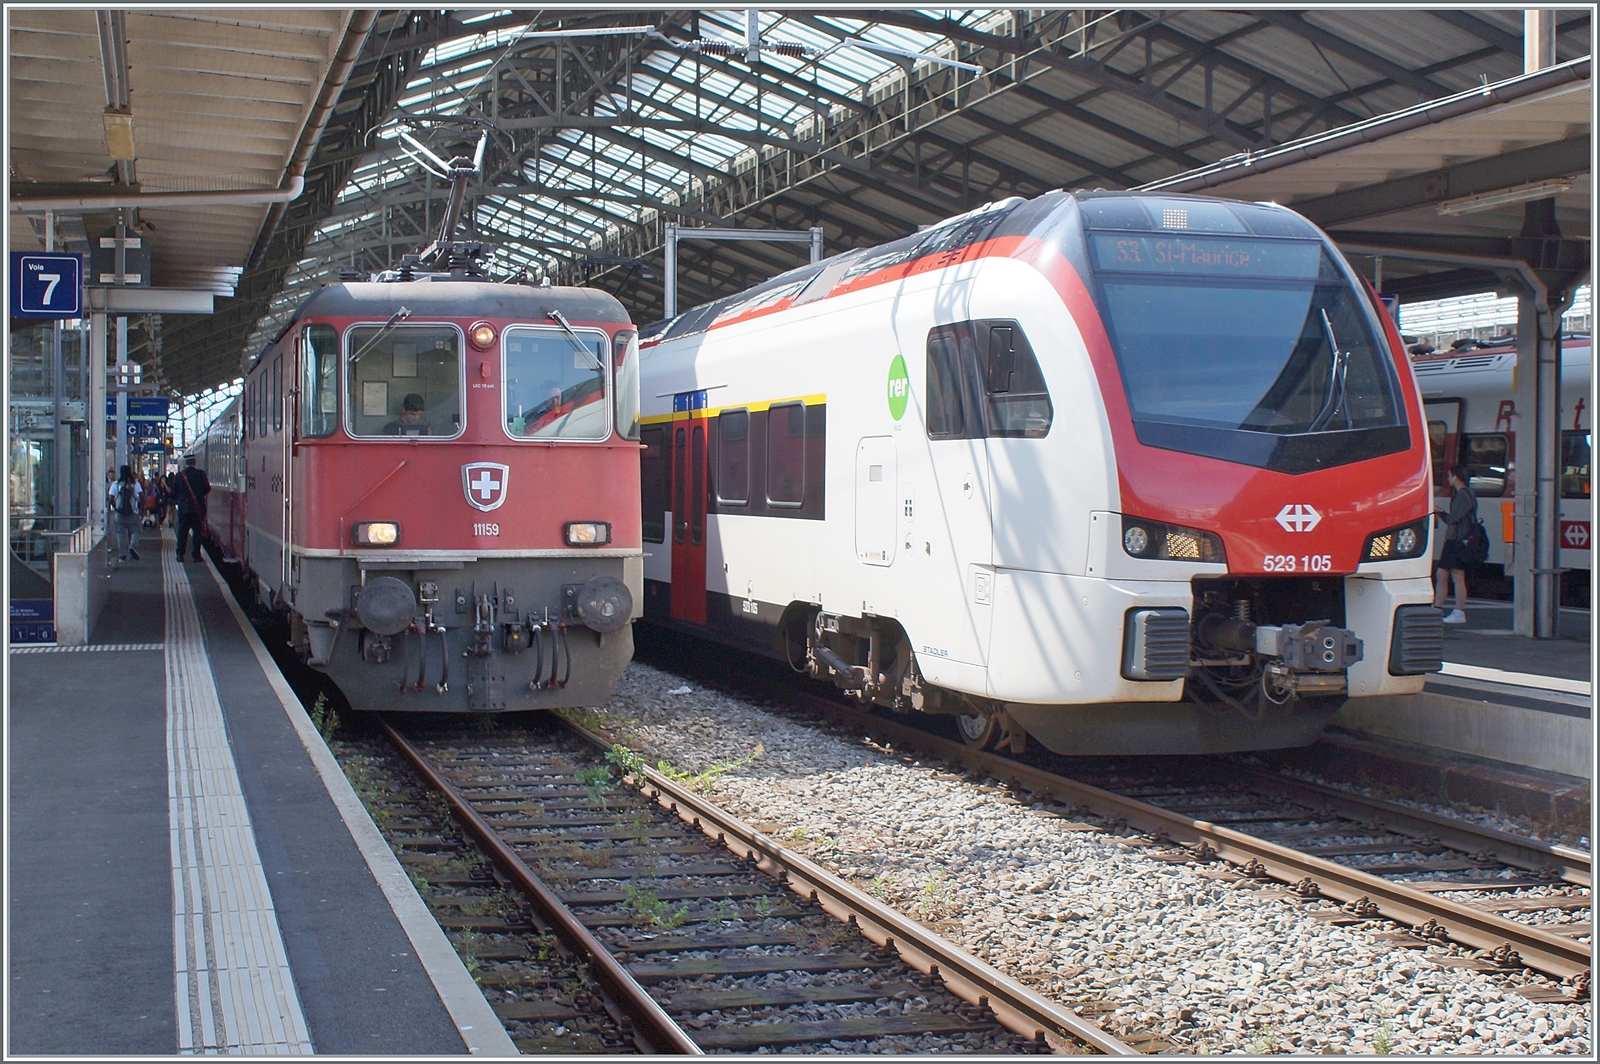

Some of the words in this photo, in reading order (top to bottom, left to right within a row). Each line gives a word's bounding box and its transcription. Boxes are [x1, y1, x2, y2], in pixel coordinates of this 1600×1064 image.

[1117, 239, 1141, 262] S3
[28, 263, 45, 271] Voie
[38, 273, 61, 306] 7
[889, 377, 908, 399] rer
[128, 425, 137, 435] C
[146, 425, 153, 435] 7
[473, 523, 499, 536] 11159
[1262, 554, 1296, 572] 523
[1301, 554, 1332, 572] 105
[18, 630, 23, 639] 1
[41, 630, 48, 639] 6
[923, 645, 949, 657] STADLER
